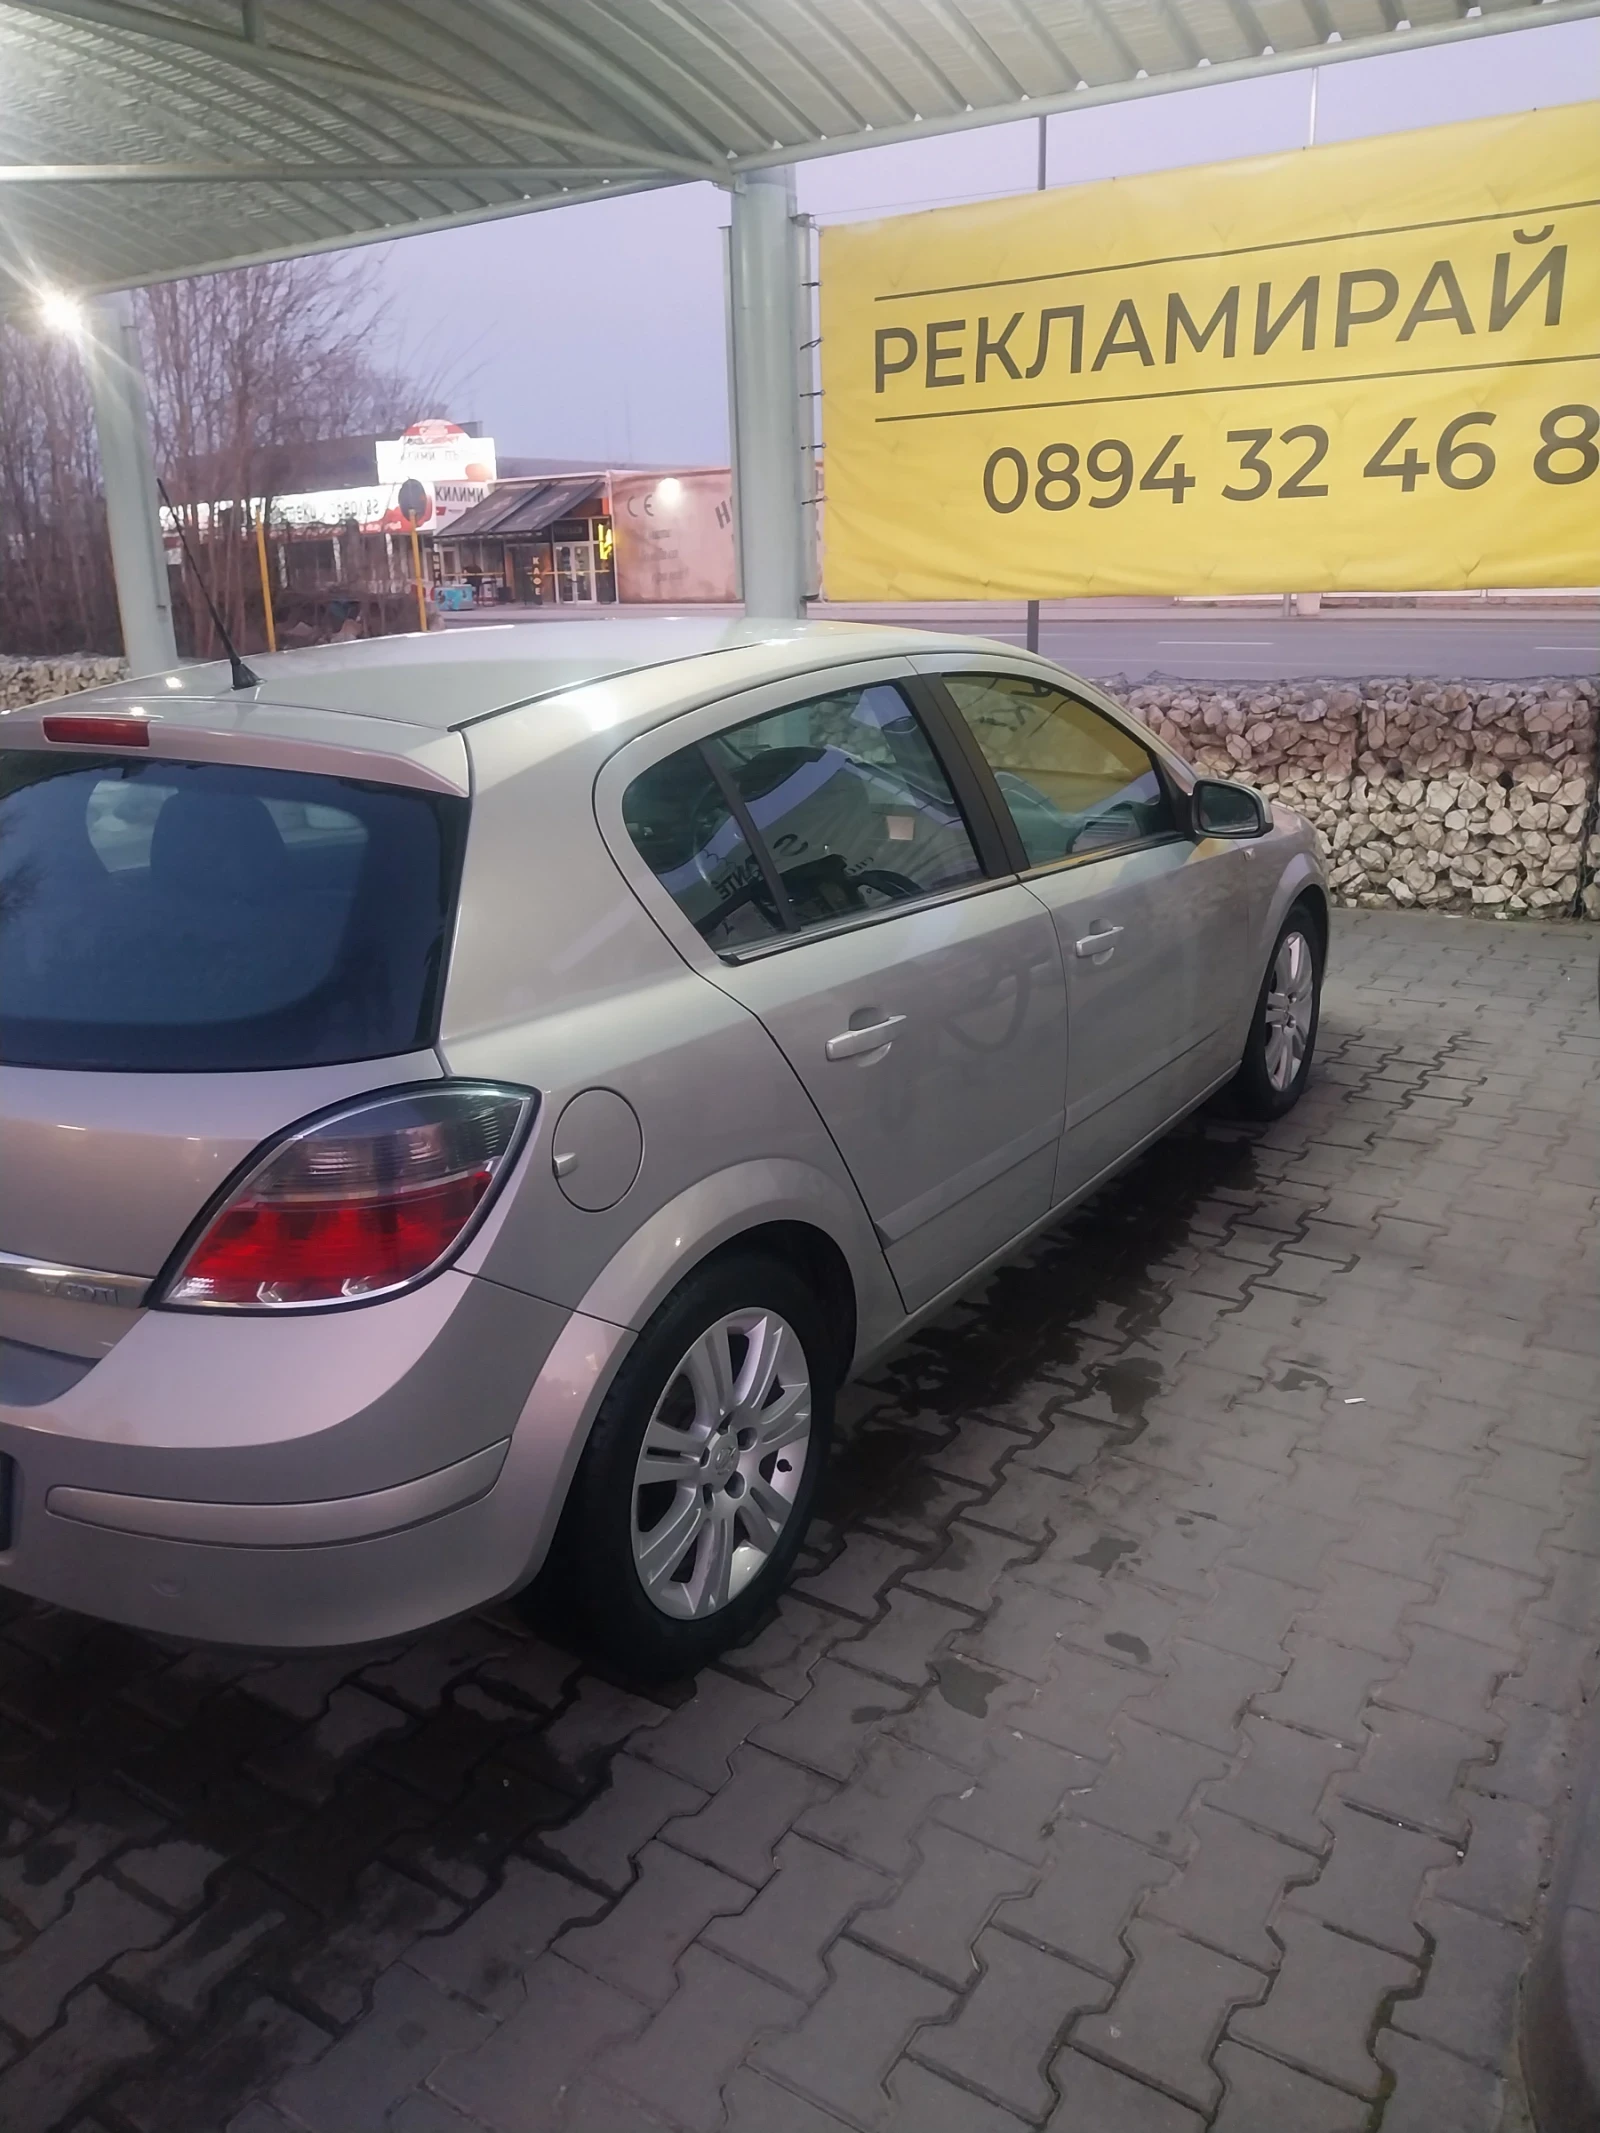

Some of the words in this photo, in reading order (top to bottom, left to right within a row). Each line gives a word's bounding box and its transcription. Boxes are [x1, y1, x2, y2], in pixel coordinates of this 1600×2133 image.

[875, 225, 1568, 393] РЕКЛАМИРАЙ
[435, 486, 484, 503] КИЛИМИ
[983, 434, 1196, 514] 0894
[1221, 424, 1330, 502] 32
[1363, 411, 1497, 493] 46
[1533, 404, 1600, 486] 8
[532, 556, 542, 596] КАФЕ
